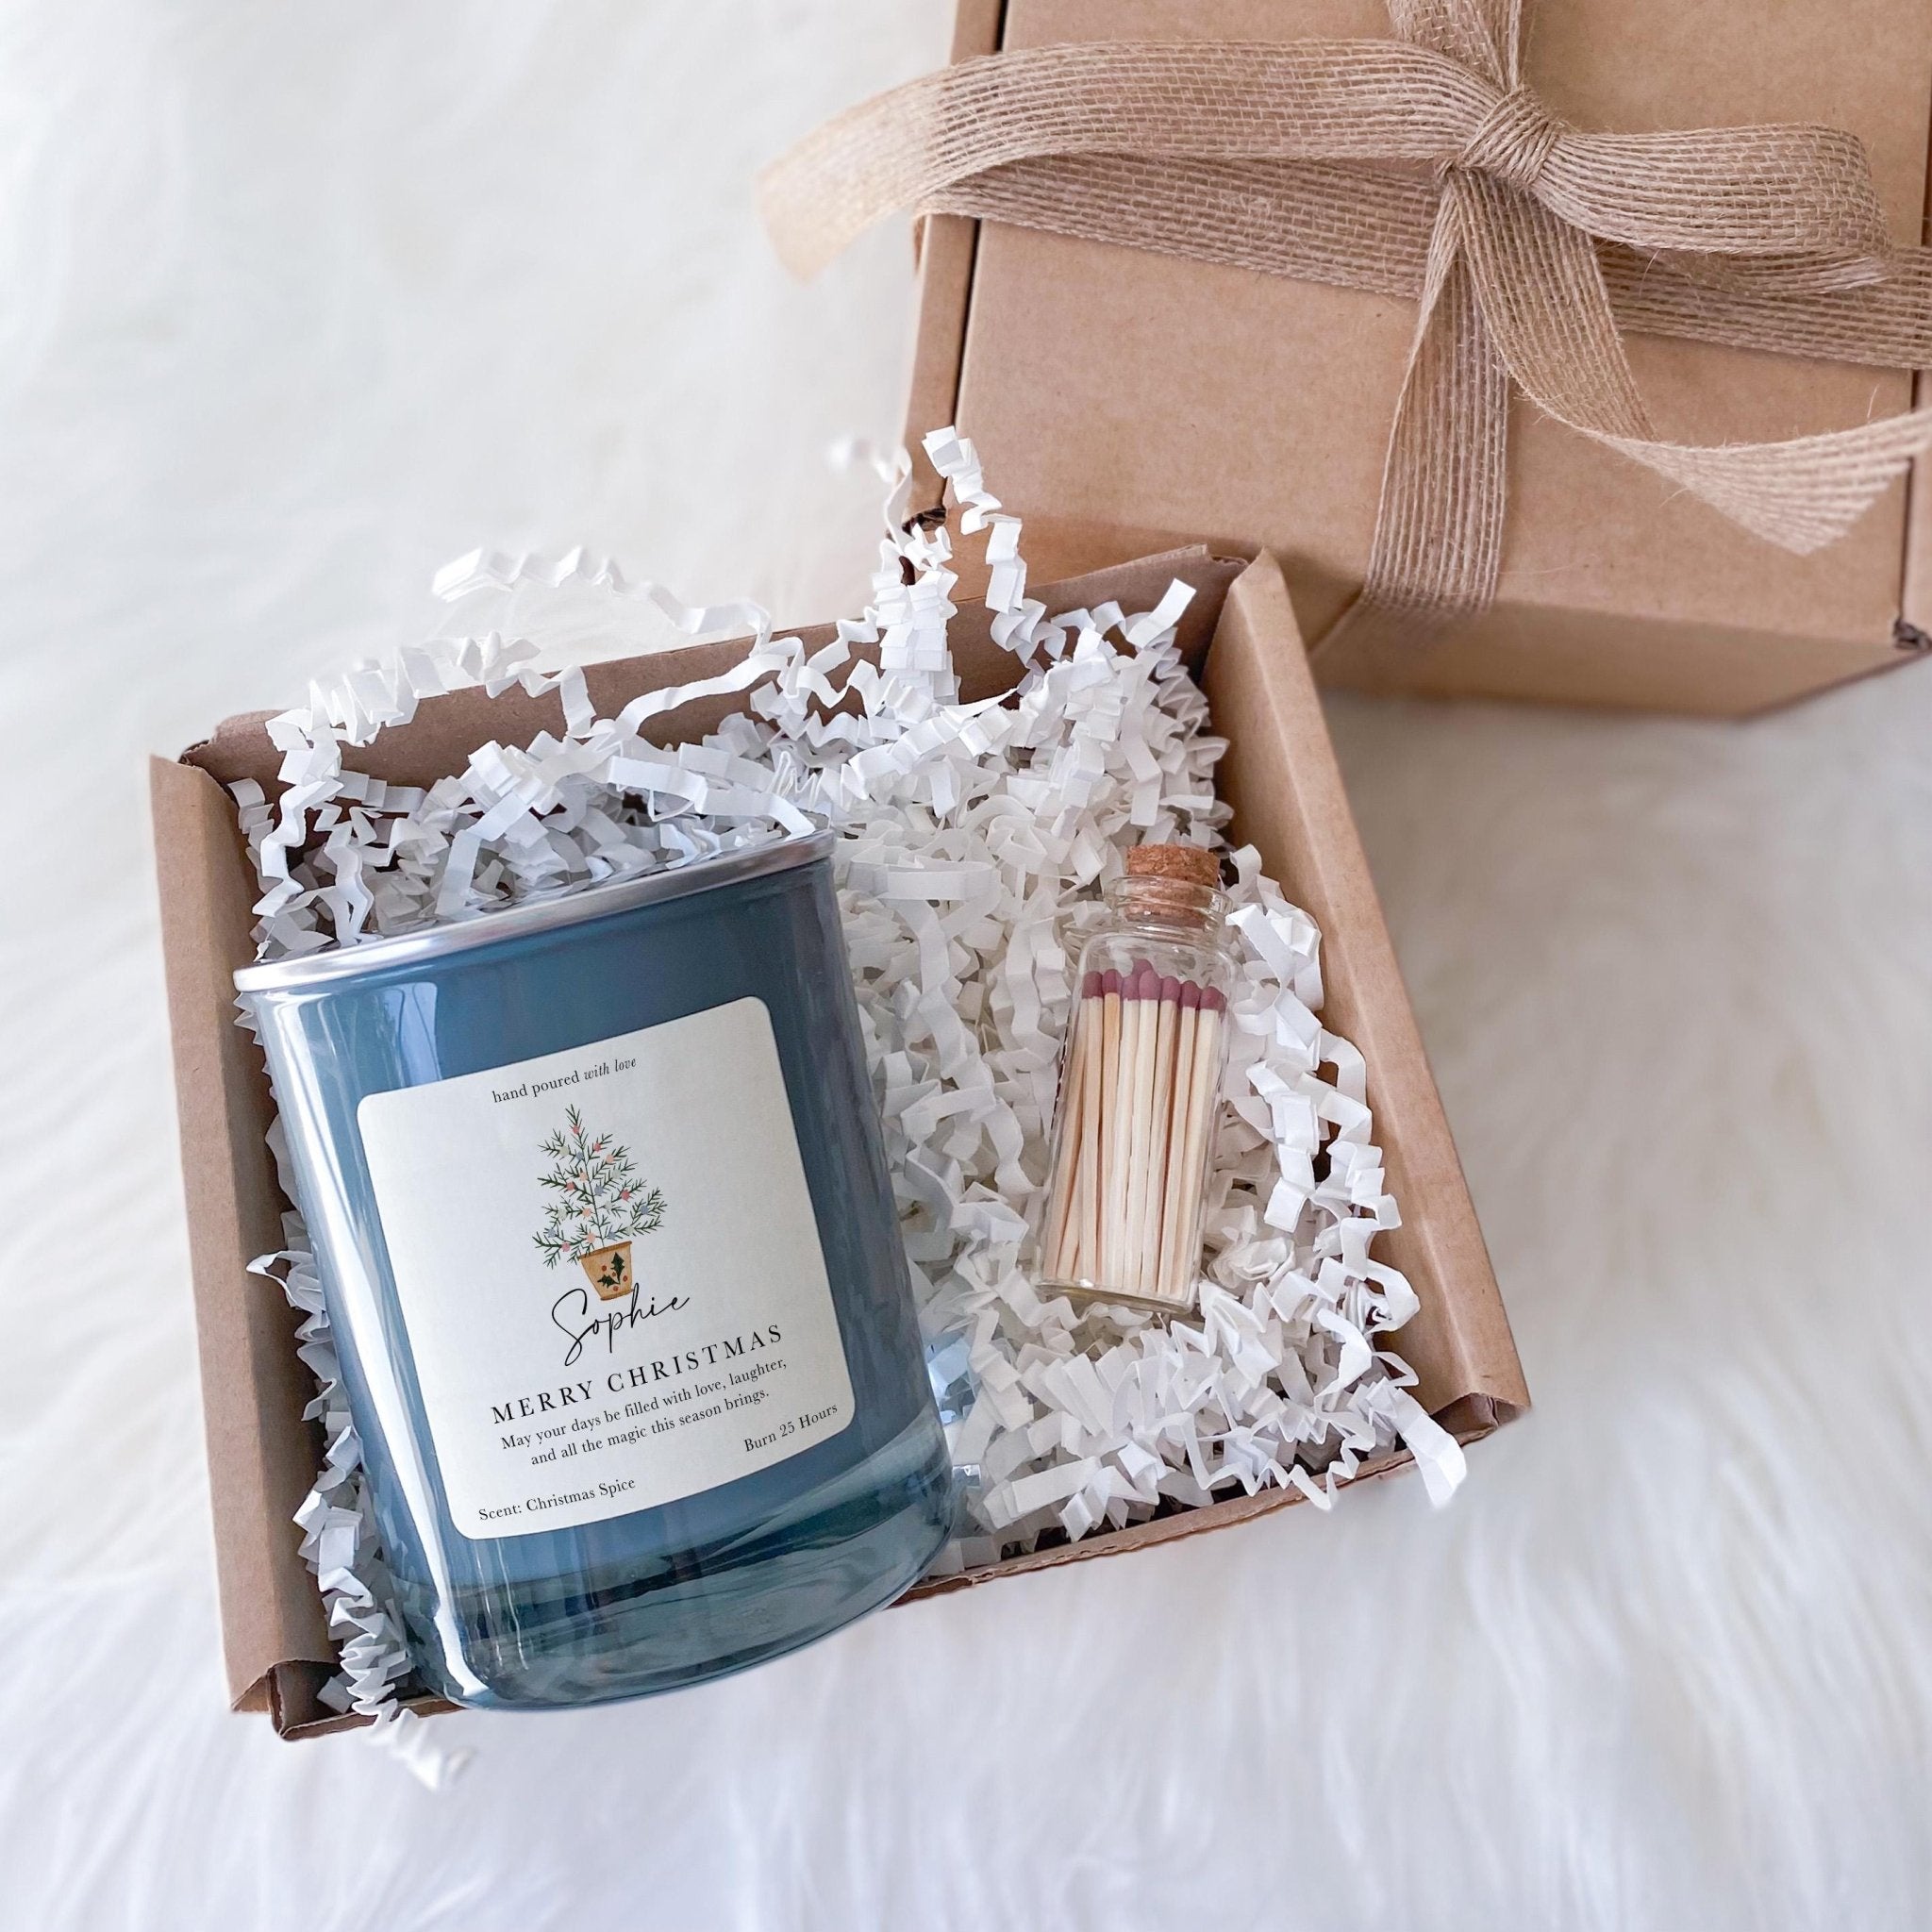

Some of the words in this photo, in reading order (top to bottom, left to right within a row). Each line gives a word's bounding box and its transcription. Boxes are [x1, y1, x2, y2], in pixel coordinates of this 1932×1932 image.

[491, 1083, 528, 1103] hand
[531, 1070, 580, 1098] poured
[583, 1062, 609, 1080] with
[614, 1058, 637, 1073] love
[552, 1283, 690, 1366] Sophie
[490, 1380, 592, 1424] MERRY
[607, 1324, 781, 1392] CHRISTMAS
[500, 1434, 531, 1450] May
[536, 1425, 566, 1445] your
[571, 1416, 602, 1432] days
[603, 1410, 621, 1423] be
[625, 1396, 659, 1418] filled
[662, 1388, 692, 1407] with
[694, 1381, 726, 1397] love,
[728, 1359, 787, 1386] laughter,
[531, 1447, 557, 1465] and
[560, 1442, 578, 1458] all
[581, 1439, 604, 1453] the
[607, 1425, 647, 1446] magic
[651, 1417, 675, 1434] this
[678, 1405, 722, 1426] season
[724, 1390, 769, 1410] brings.
[743, 1433, 777, 1452] Burn
[779, 1421, 795, 1438] 25
[798, 1405, 838, 1429] Hours
[478, 1505, 522, 1521] Scent:
[525, 1490, 595, 1511] Christmas
[598, 1479, 636, 1498] Spice
